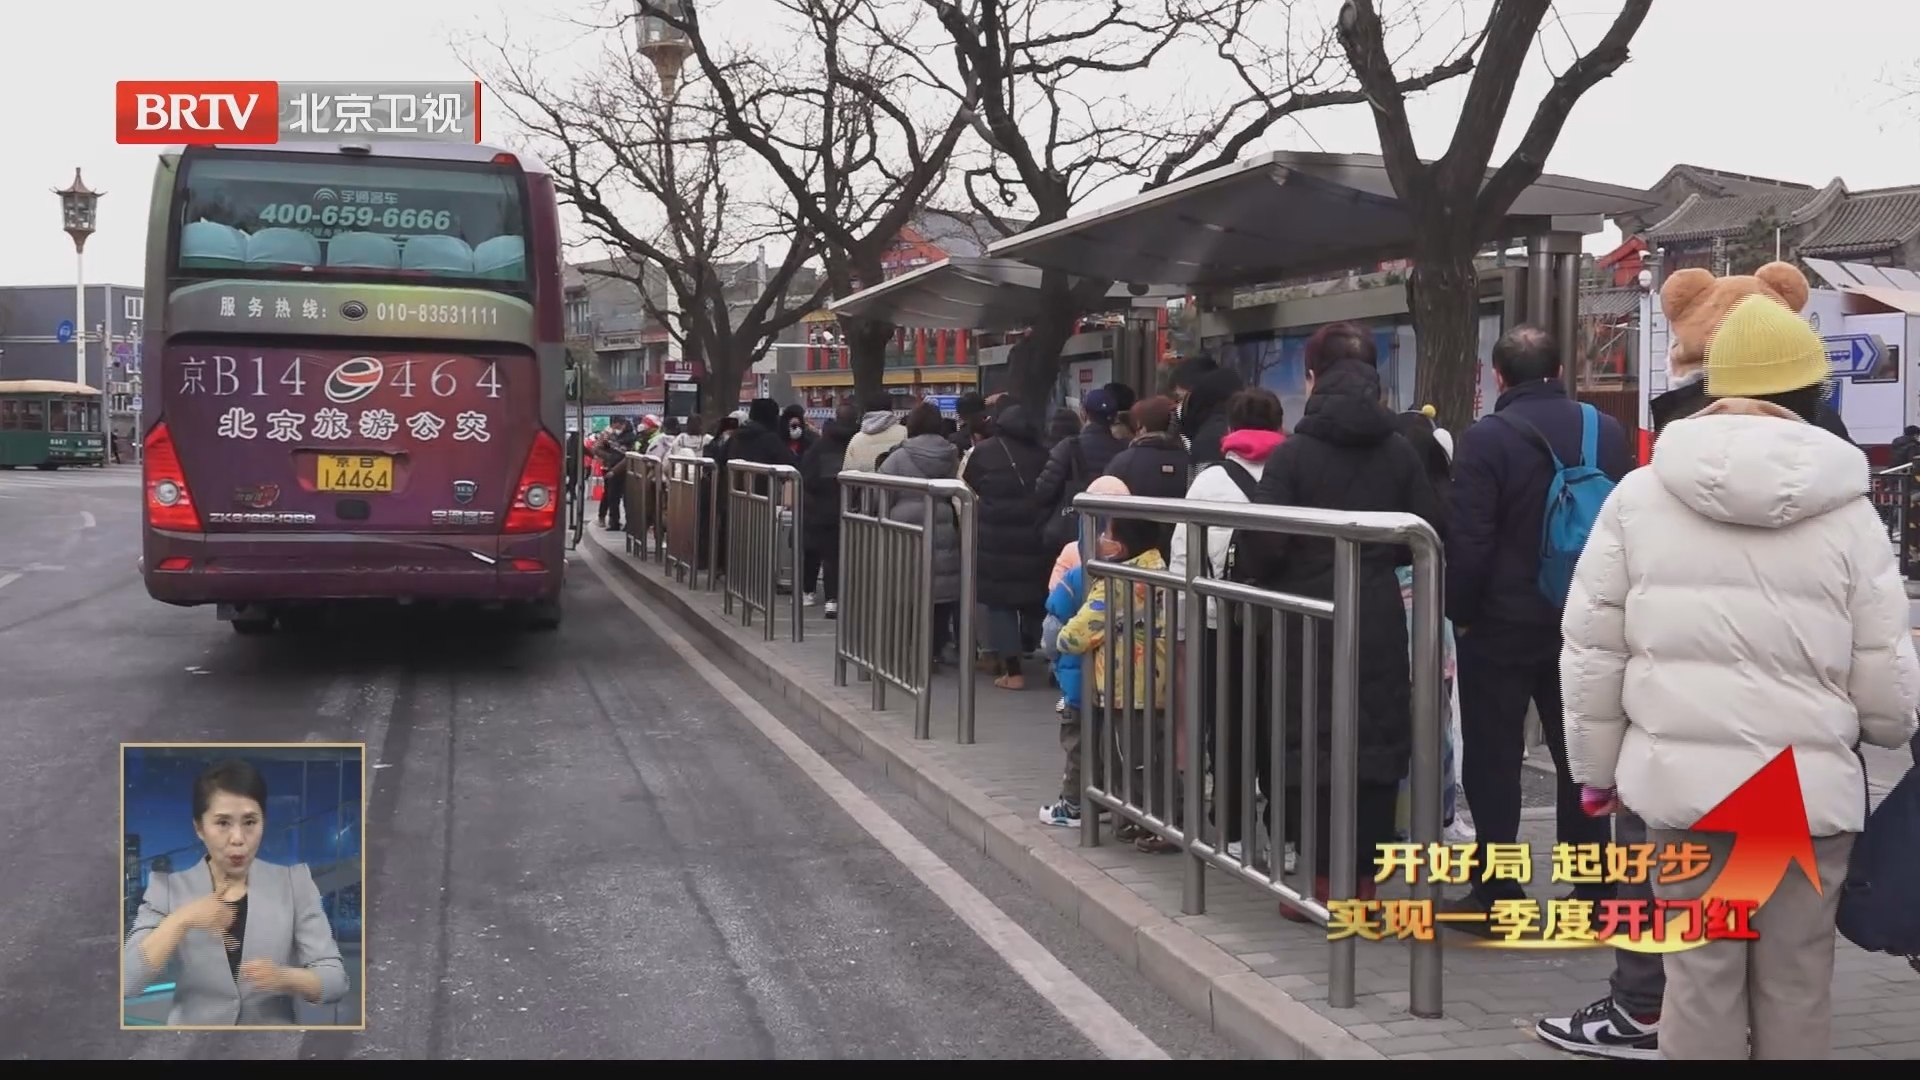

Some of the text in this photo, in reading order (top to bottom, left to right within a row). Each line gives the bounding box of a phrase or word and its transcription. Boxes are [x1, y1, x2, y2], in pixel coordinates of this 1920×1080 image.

[340, 189, 399, 205] 宇通客车
[259, 202, 451, 230] 400-659-6666
[376, 302, 498, 325] 010-83531111
[179, 356, 502, 398] 京B14 464
[217, 406, 492, 443] 北京旅游公交
[325, 468, 388, 489] 14464
